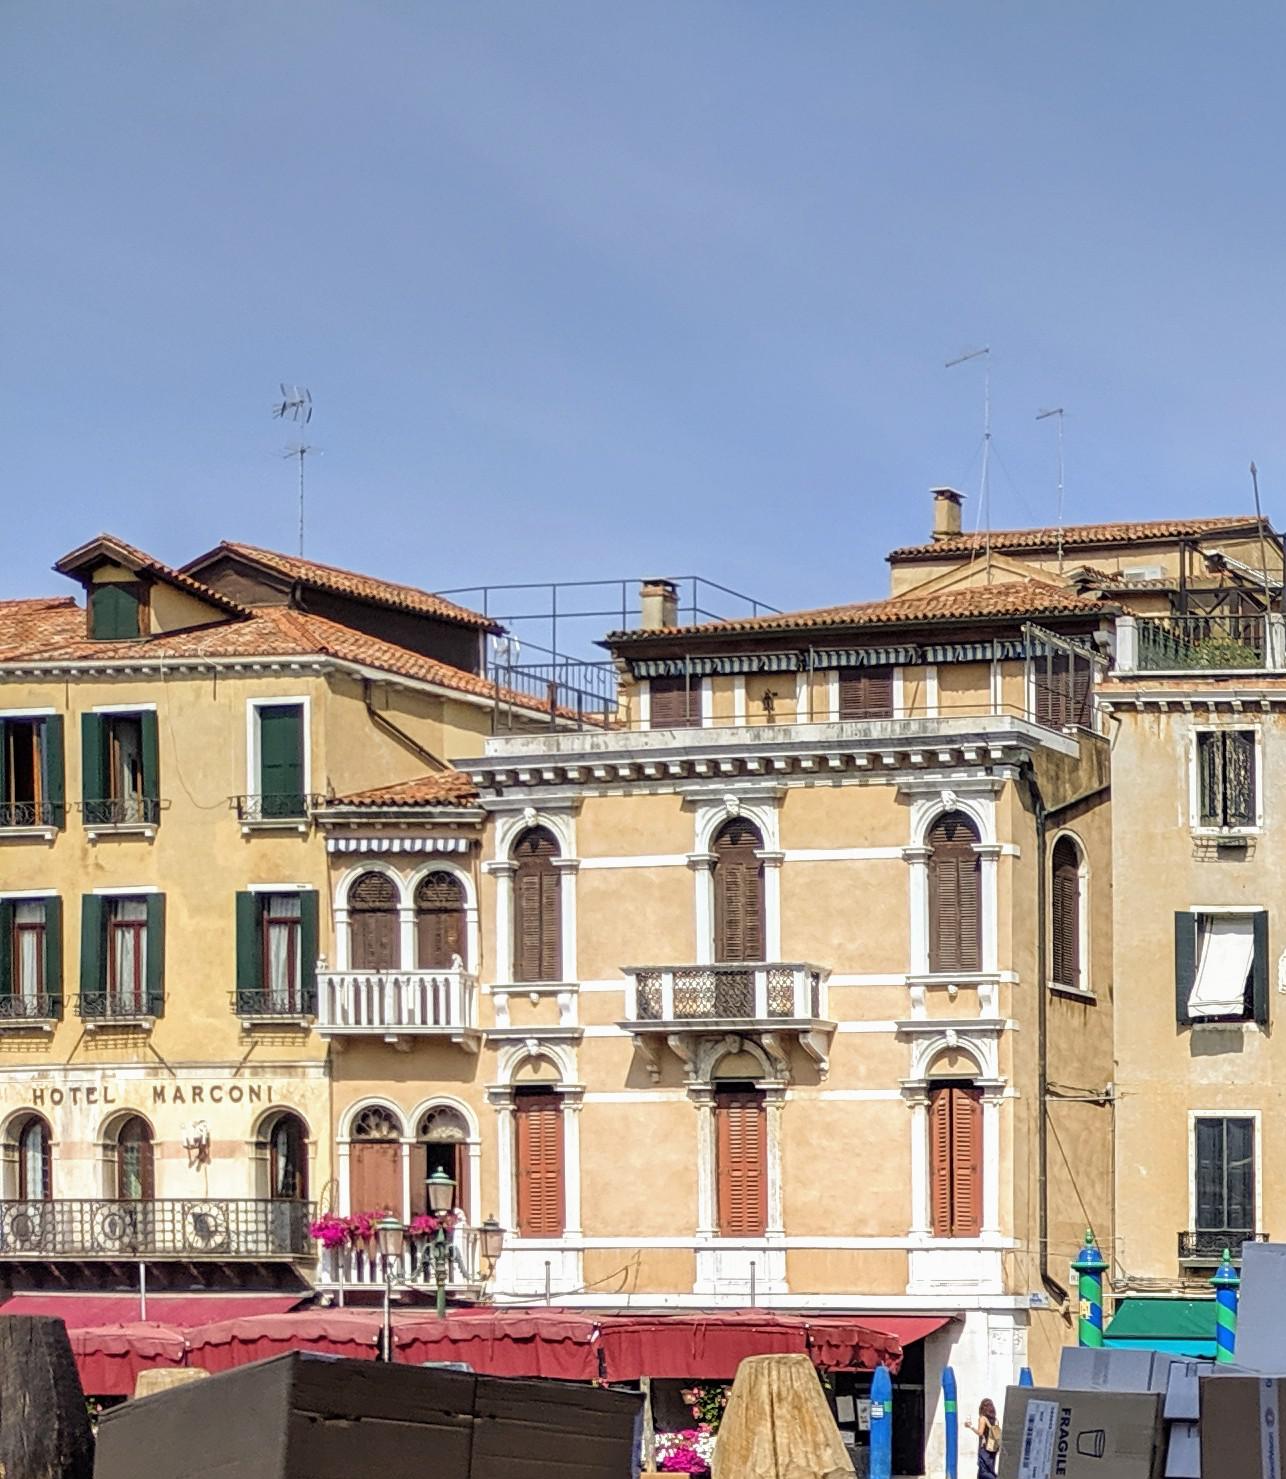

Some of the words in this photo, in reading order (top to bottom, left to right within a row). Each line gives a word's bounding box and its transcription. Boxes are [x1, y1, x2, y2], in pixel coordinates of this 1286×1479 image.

[32, 1085, 117, 1106] HOTEL
[152, 1084, 274, 1105] MARCONI
[1055, 1407, 1073, 1477] FRAGILE
